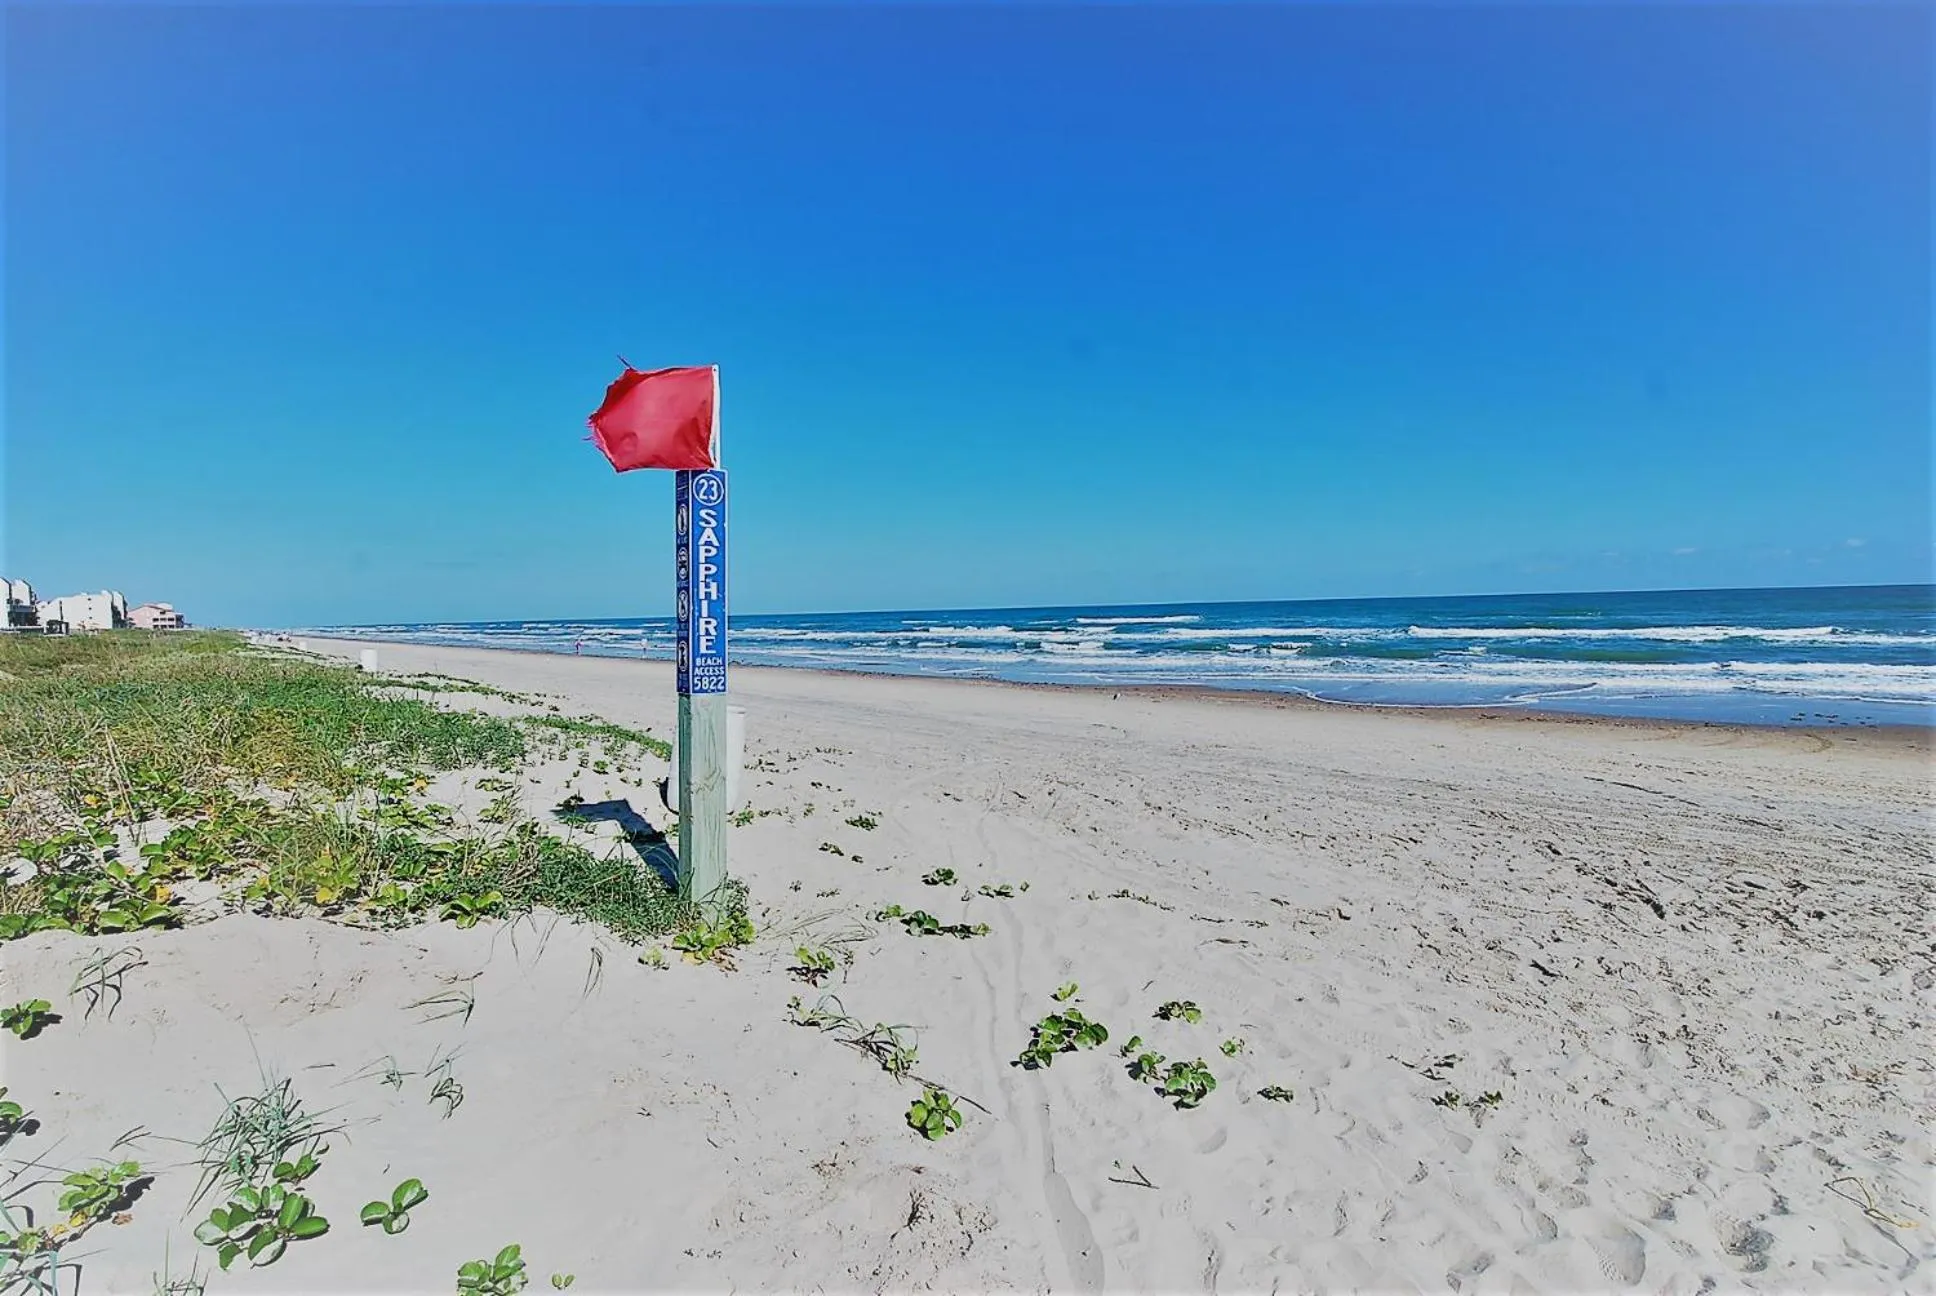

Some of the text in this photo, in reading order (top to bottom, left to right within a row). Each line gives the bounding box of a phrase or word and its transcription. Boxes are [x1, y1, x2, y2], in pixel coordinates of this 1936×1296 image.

[698, 478, 719, 500] 23
[698, 509, 720, 654] SAPPHIRE
[696, 657, 722, 666] BEACH
[694, 667, 724, 676] ACCESS
[694, 677, 725, 690] 5822
